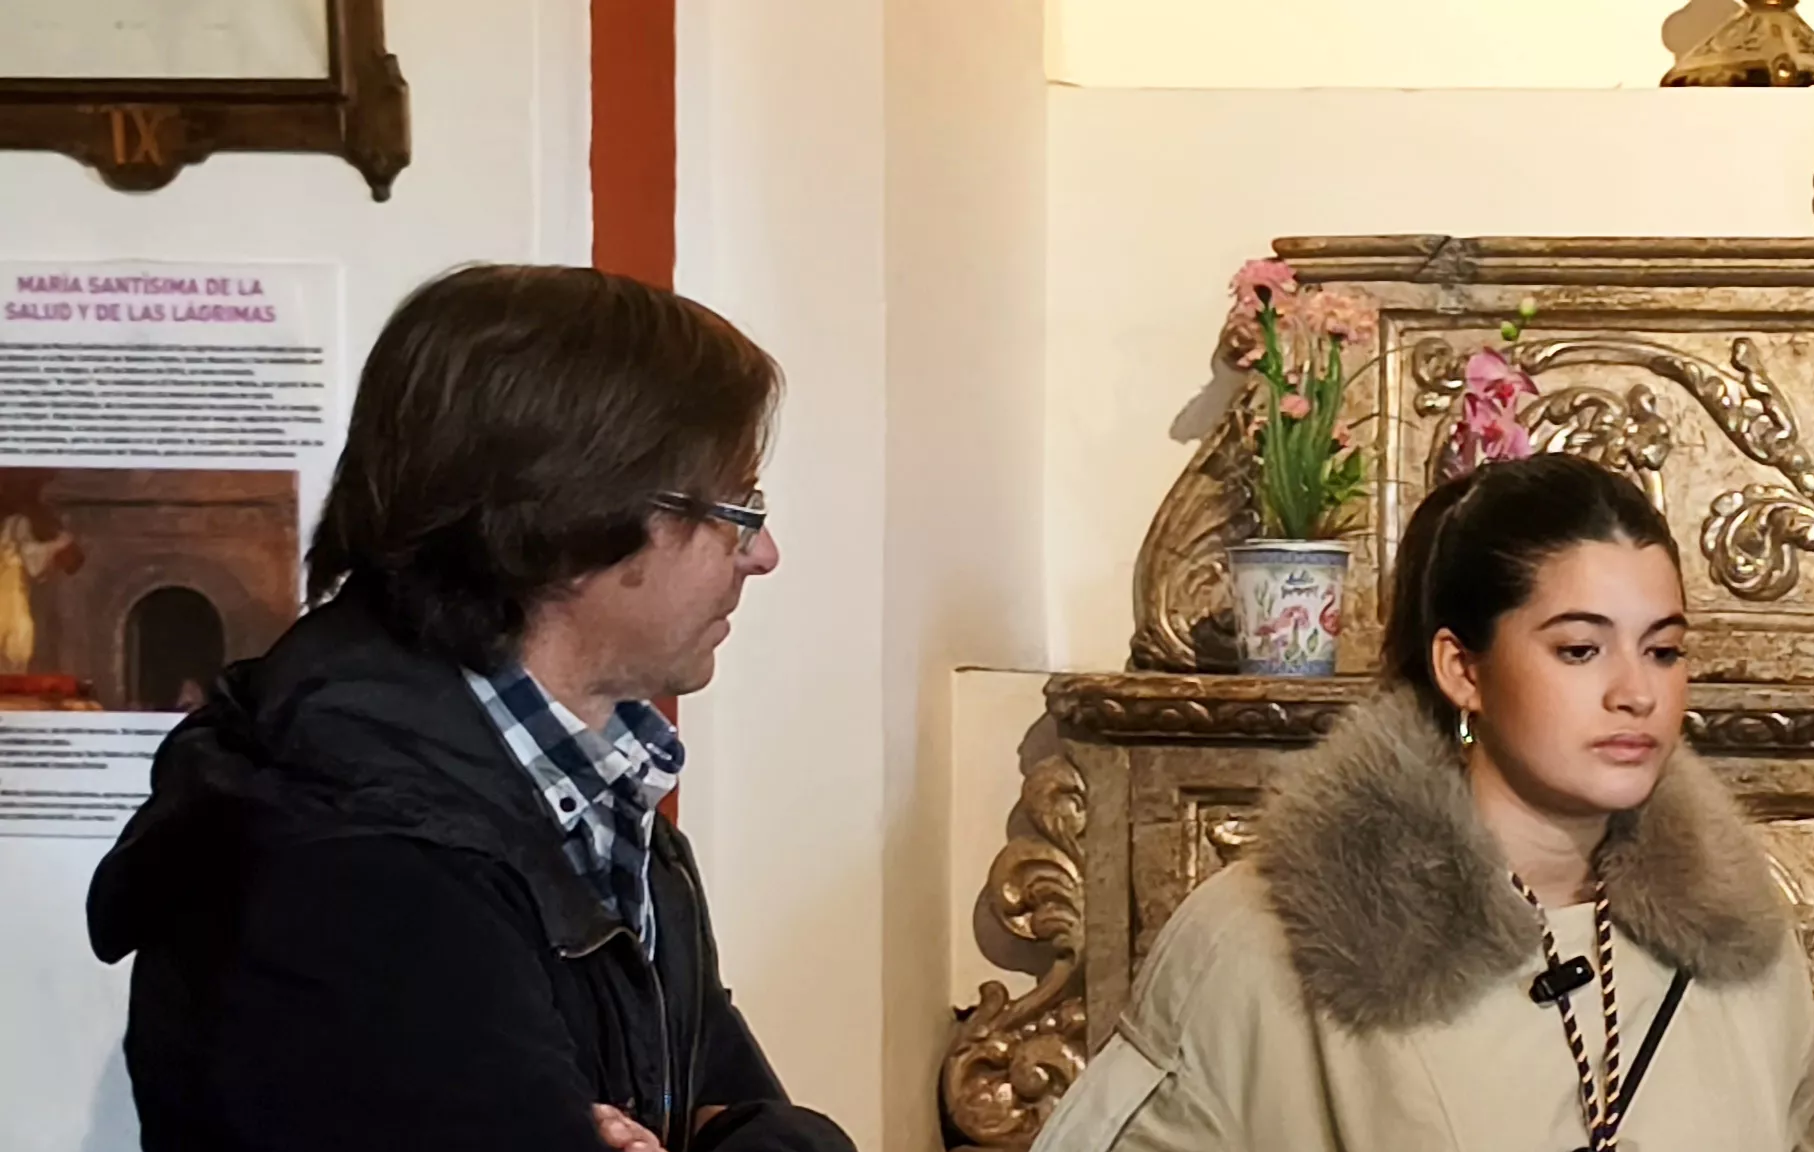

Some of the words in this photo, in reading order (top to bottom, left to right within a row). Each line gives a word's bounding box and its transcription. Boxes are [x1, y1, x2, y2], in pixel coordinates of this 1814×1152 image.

[17, 273, 82, 293] MARÍA
[88, 273, 199, 295] SANTÍSIMA
[206, 277, 231, 296] DE
[237, 278, 264, 297] LA
[4, 302, 73, 321] SALUD
[78, 303, 89, 321] Y
[96, 304, 121, 321] DE
[128, 304, 166, 322] LAS
[172, 302, 277, 323] LÁGRIMAS
